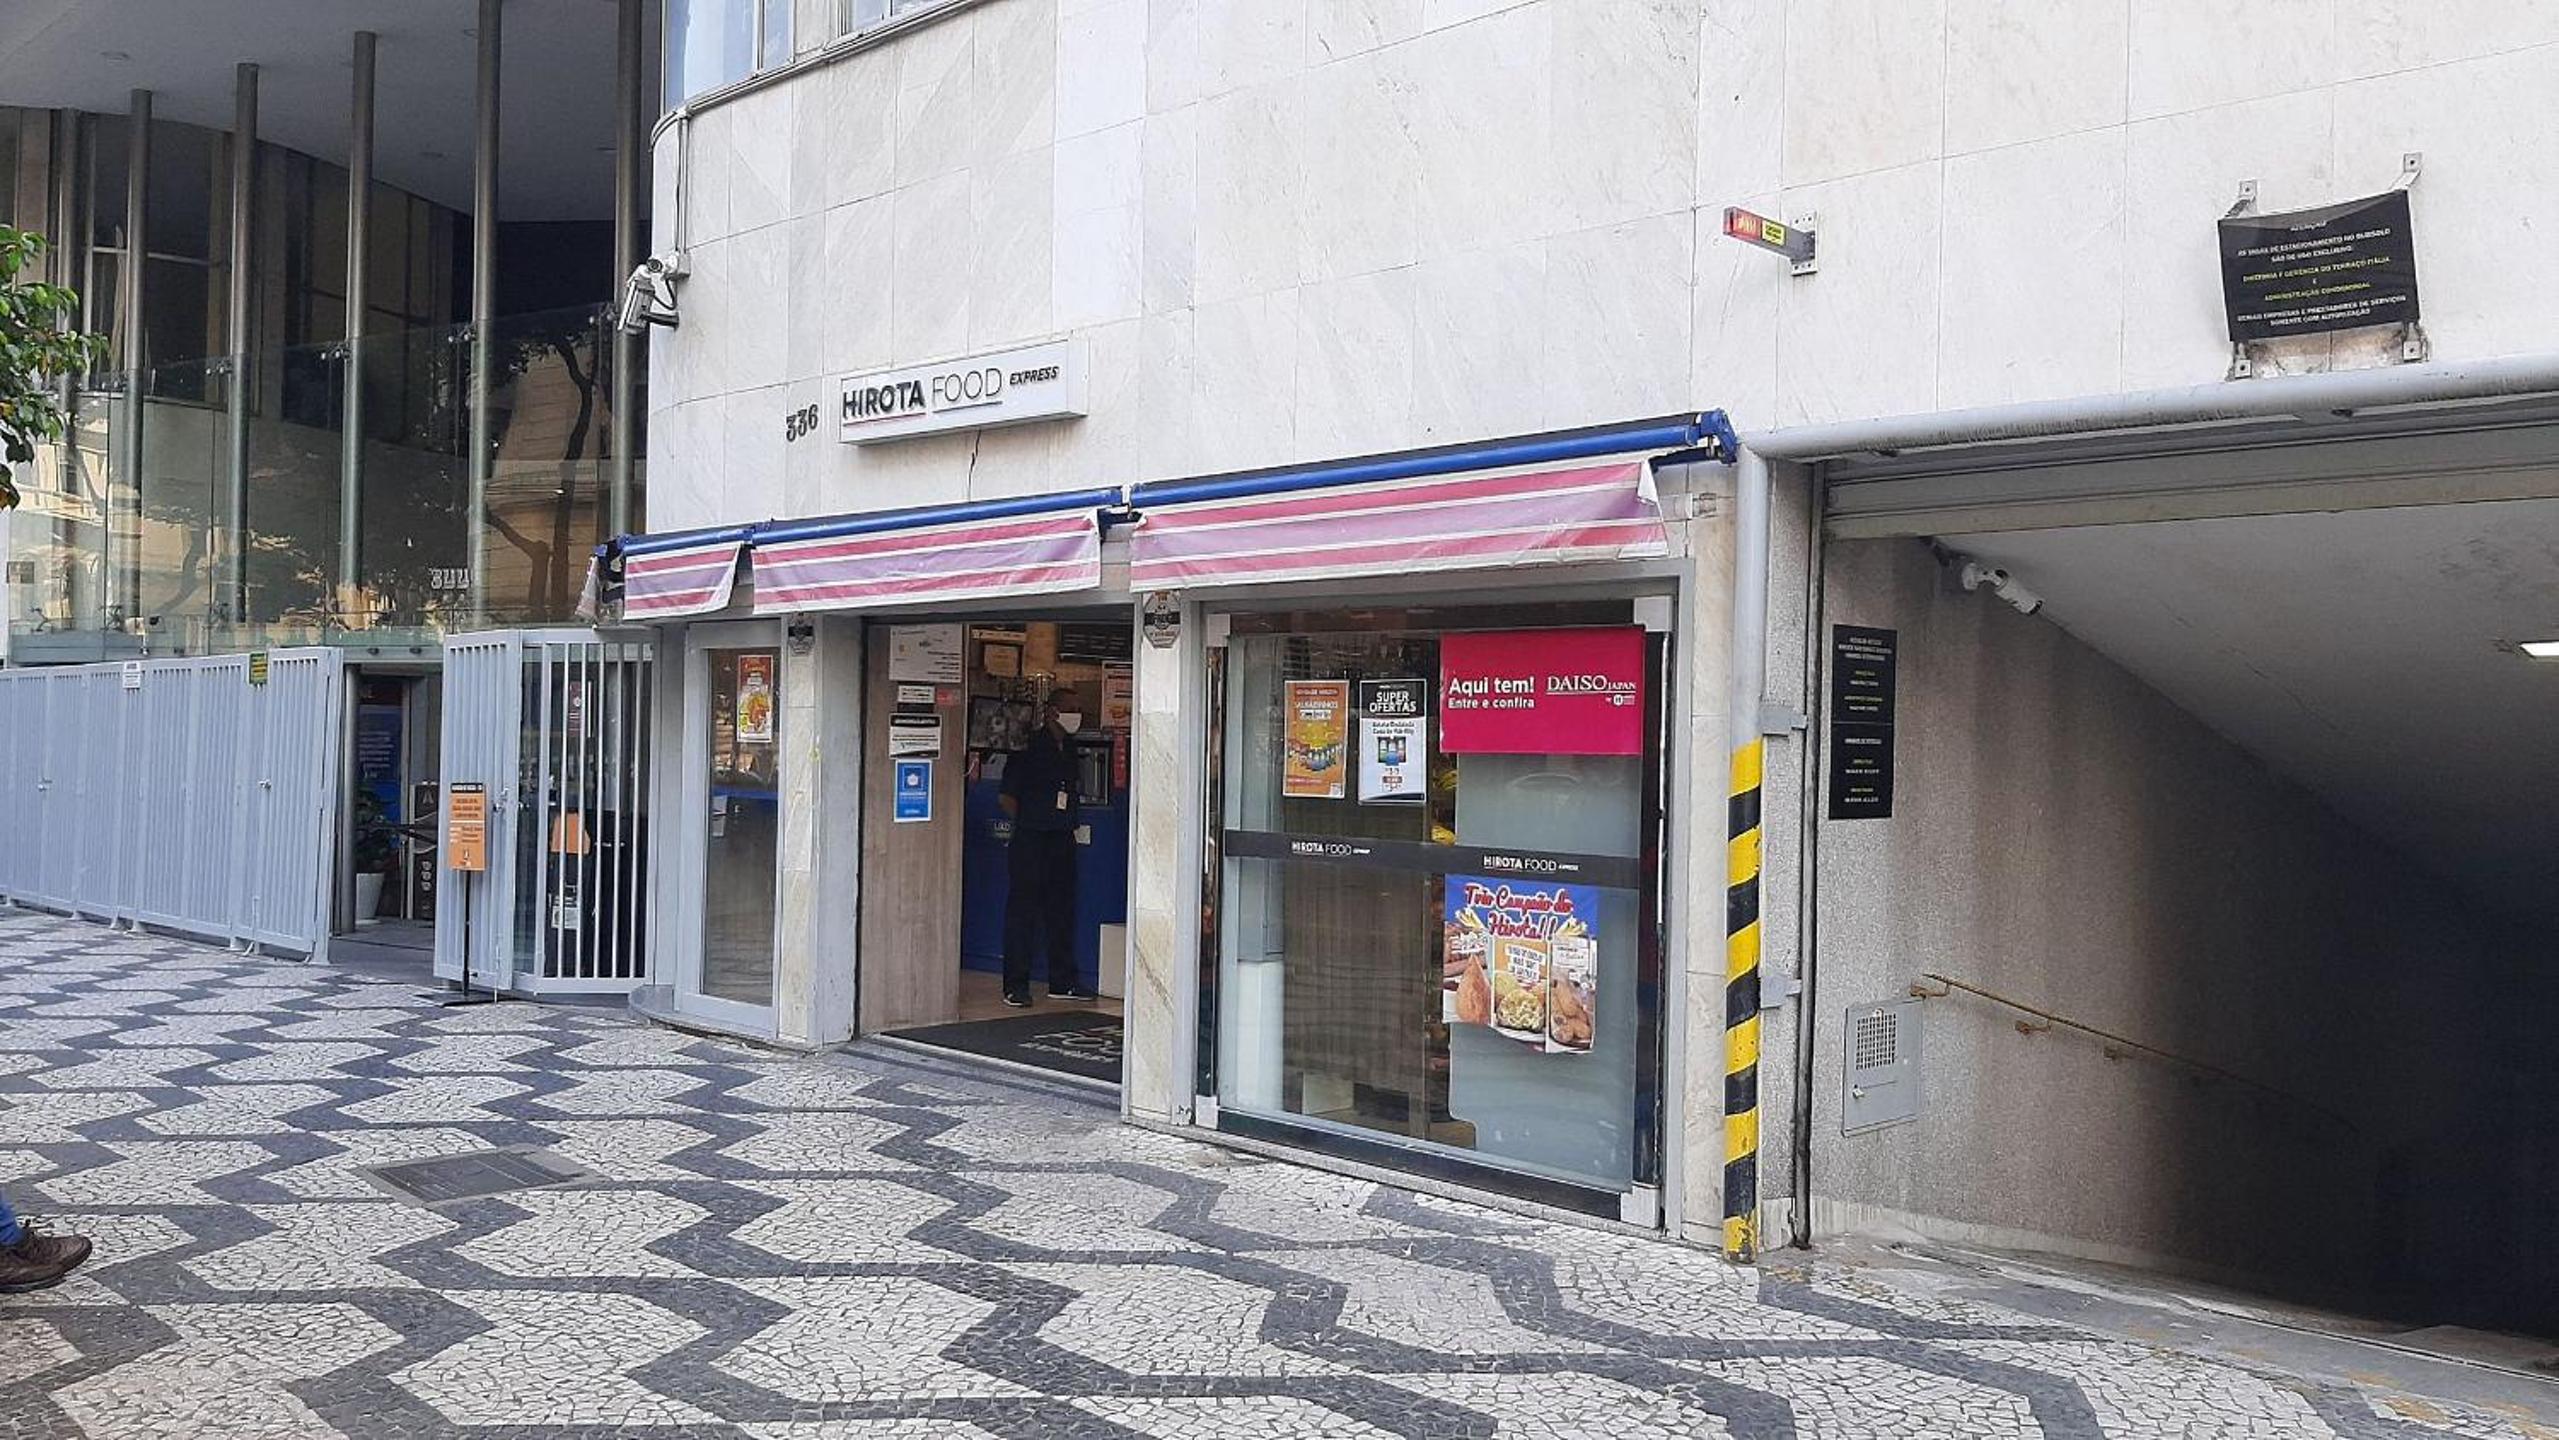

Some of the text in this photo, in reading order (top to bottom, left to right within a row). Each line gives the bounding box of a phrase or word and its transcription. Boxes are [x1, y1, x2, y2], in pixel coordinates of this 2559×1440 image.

[2280, 236, 2342, 252] ESTACIONAMENTO
[2356, 228, 2391, 239] SUBSOLO
[2320, 264, 2331, 272] DO
[2332, 258, 2366, 271] TERRAÇO
[2359, 299, 2370, 307] DE
[2370, 295, 2406, 306] SERVIÇOS
[2270, 317, 2302, 326] SOMENTE
[2321, 308, 2370, 319] AUTORIZAÇÃO
[842, 366, 1059, 420] HIROTA FOOD EXPRESS
[786, 404, 819, 443] 336
[1449, 676, 1535, 696] Aqui tem!
[1547, 675, 1637, 692] DAISO JAPAN
[1376, 691, 1409, 702] SUPER
[1448, 697, 1535, 709] Entre e confira
[1369, 701, 1417, 713] OFERTAS
[1292, 842, 1324, 854] HIROTA
[1325, 844, 1352, 856] FOOD
[1484, 855, 1523, 869] HIROTA
[1524, 858, 1557, 871] FOOD
[1496, 885, 1554, 915] Campeão
